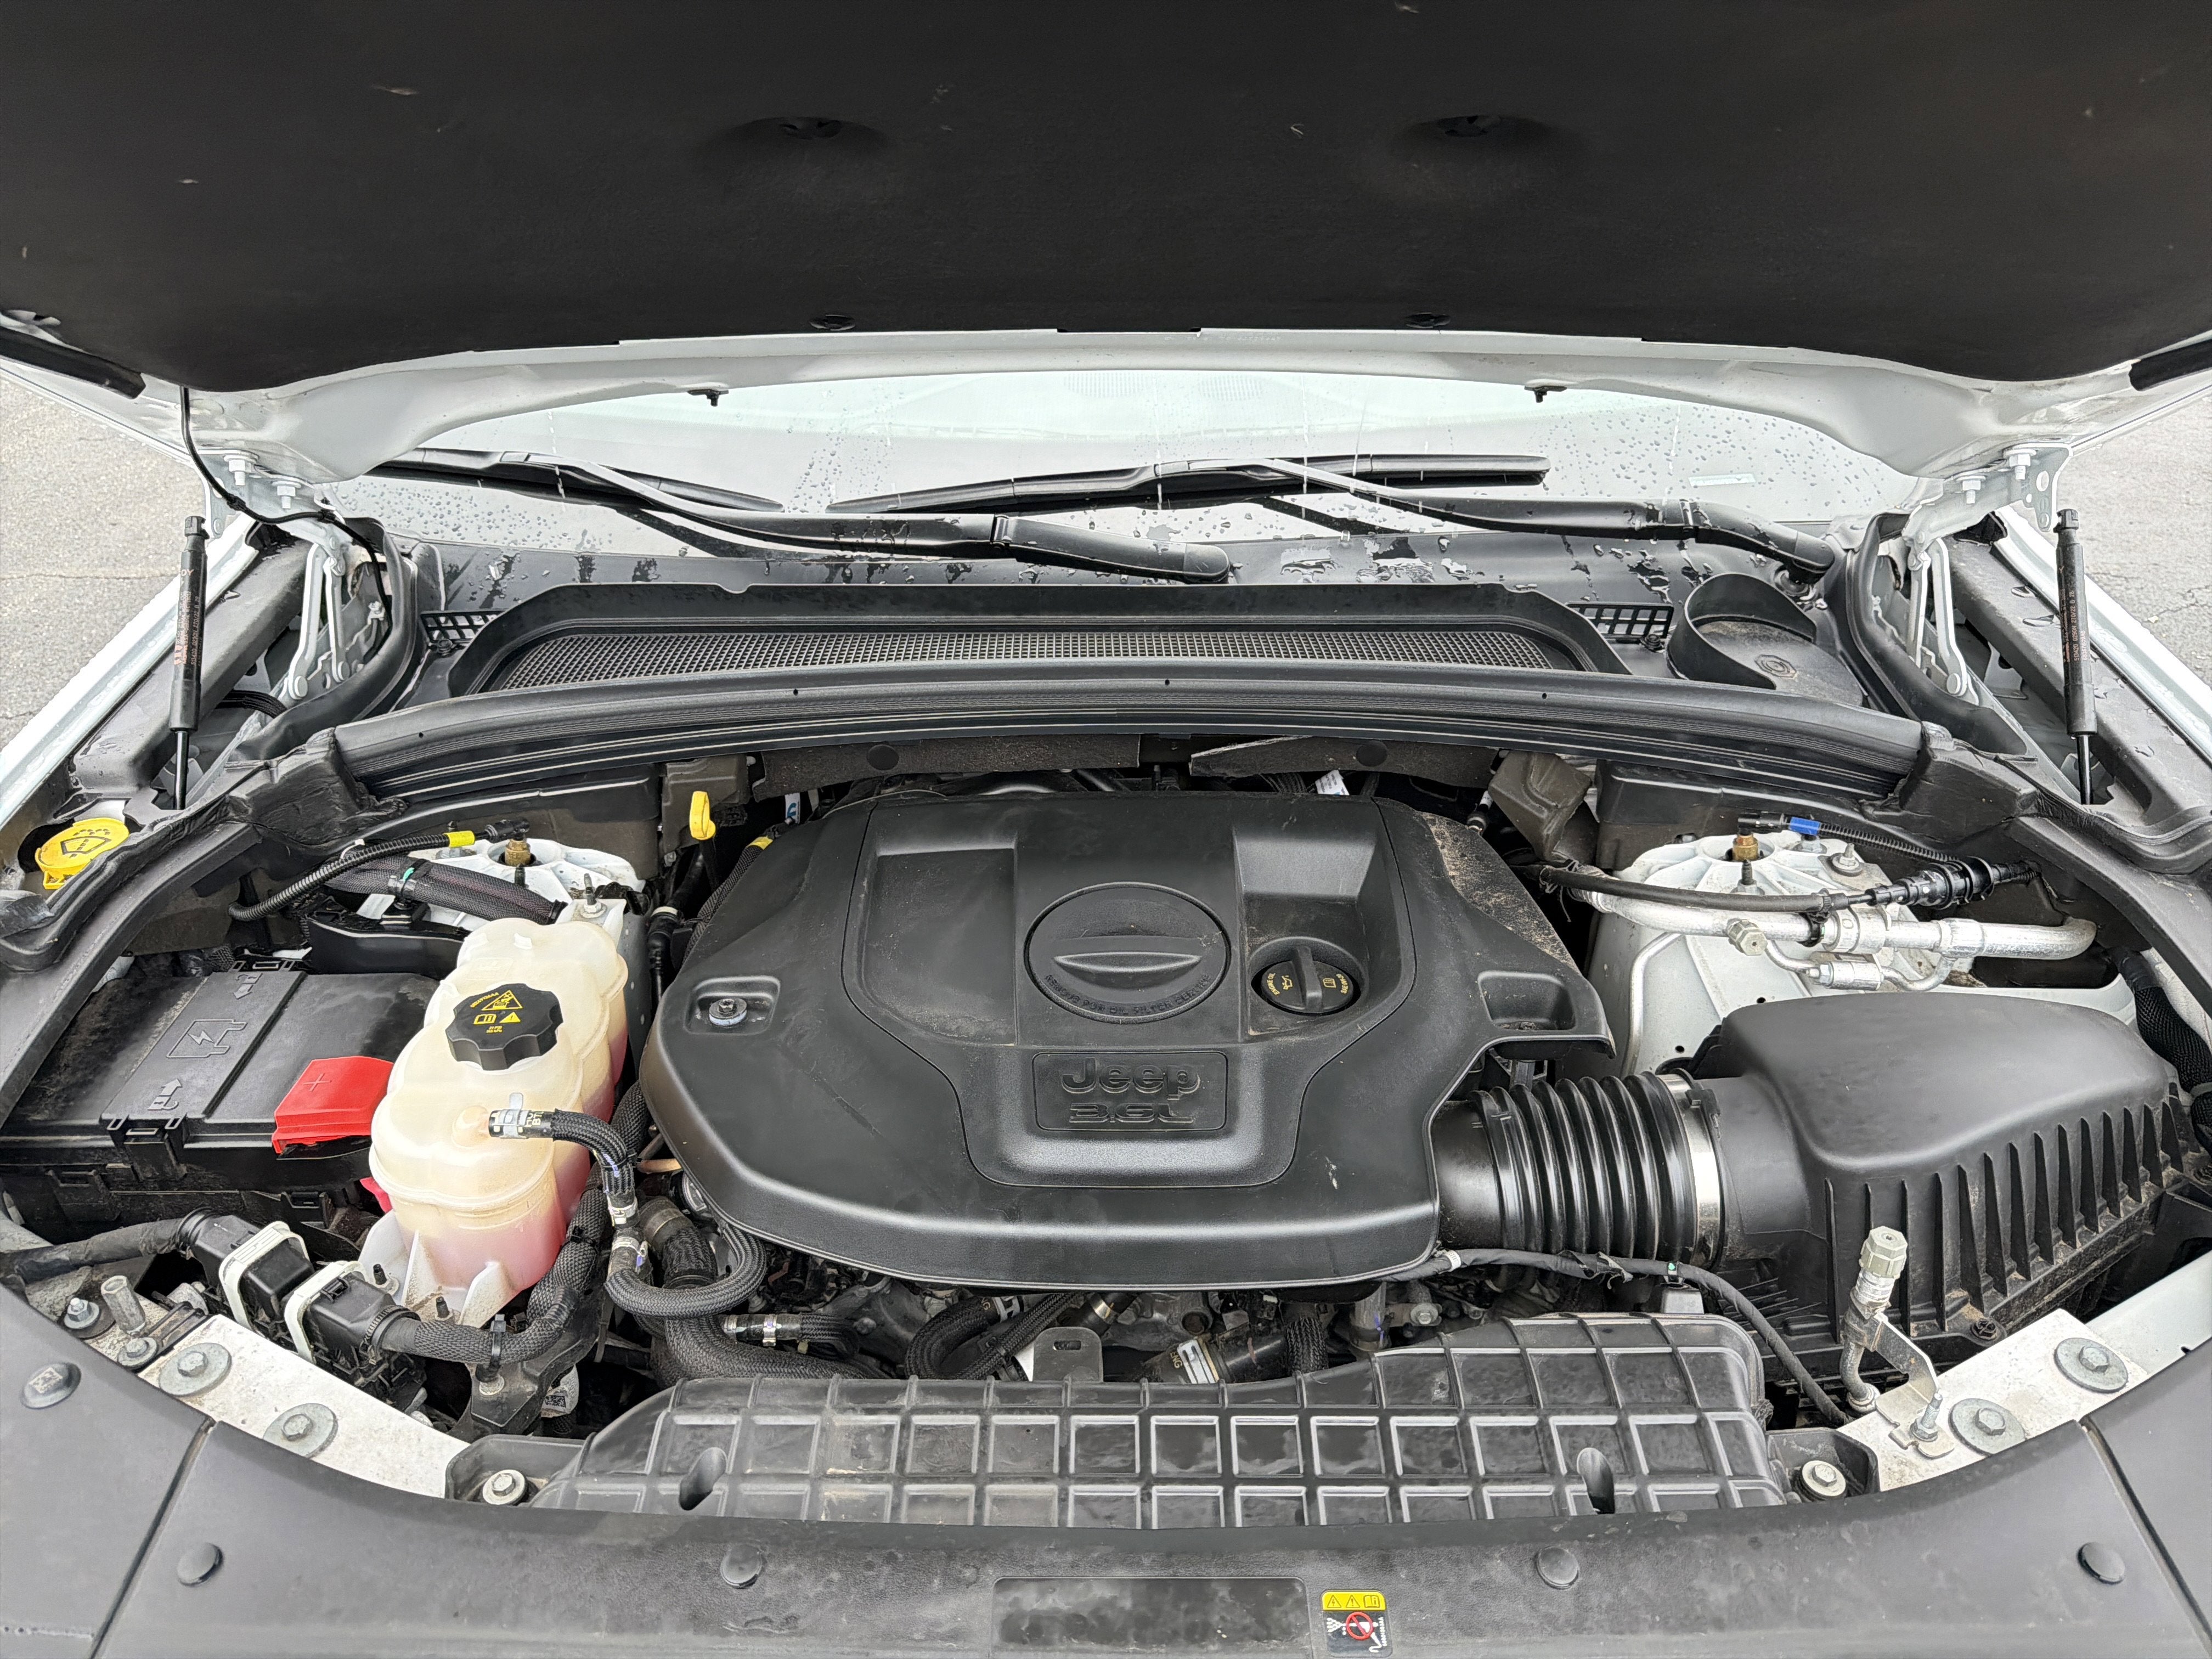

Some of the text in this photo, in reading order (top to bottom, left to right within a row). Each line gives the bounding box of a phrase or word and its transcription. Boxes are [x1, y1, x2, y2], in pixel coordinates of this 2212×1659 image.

[1084, 999, 1106, 1012] FOR
[1110, 1006, 1129, 1015] OIL
[1133, 1000, 1173, 1013] FILTER
[1175, 974, 1212, 1006] SERVICE
[1267, 980, 1280, 995] ENGINE
[1340, 985, 1348, 994] SAE
[1061, 1058, 1201, 1101] Jeep
[1069, 1102, 1194, 1124] 3.6L
[1170, 1352, 1182, 1368] ENG
